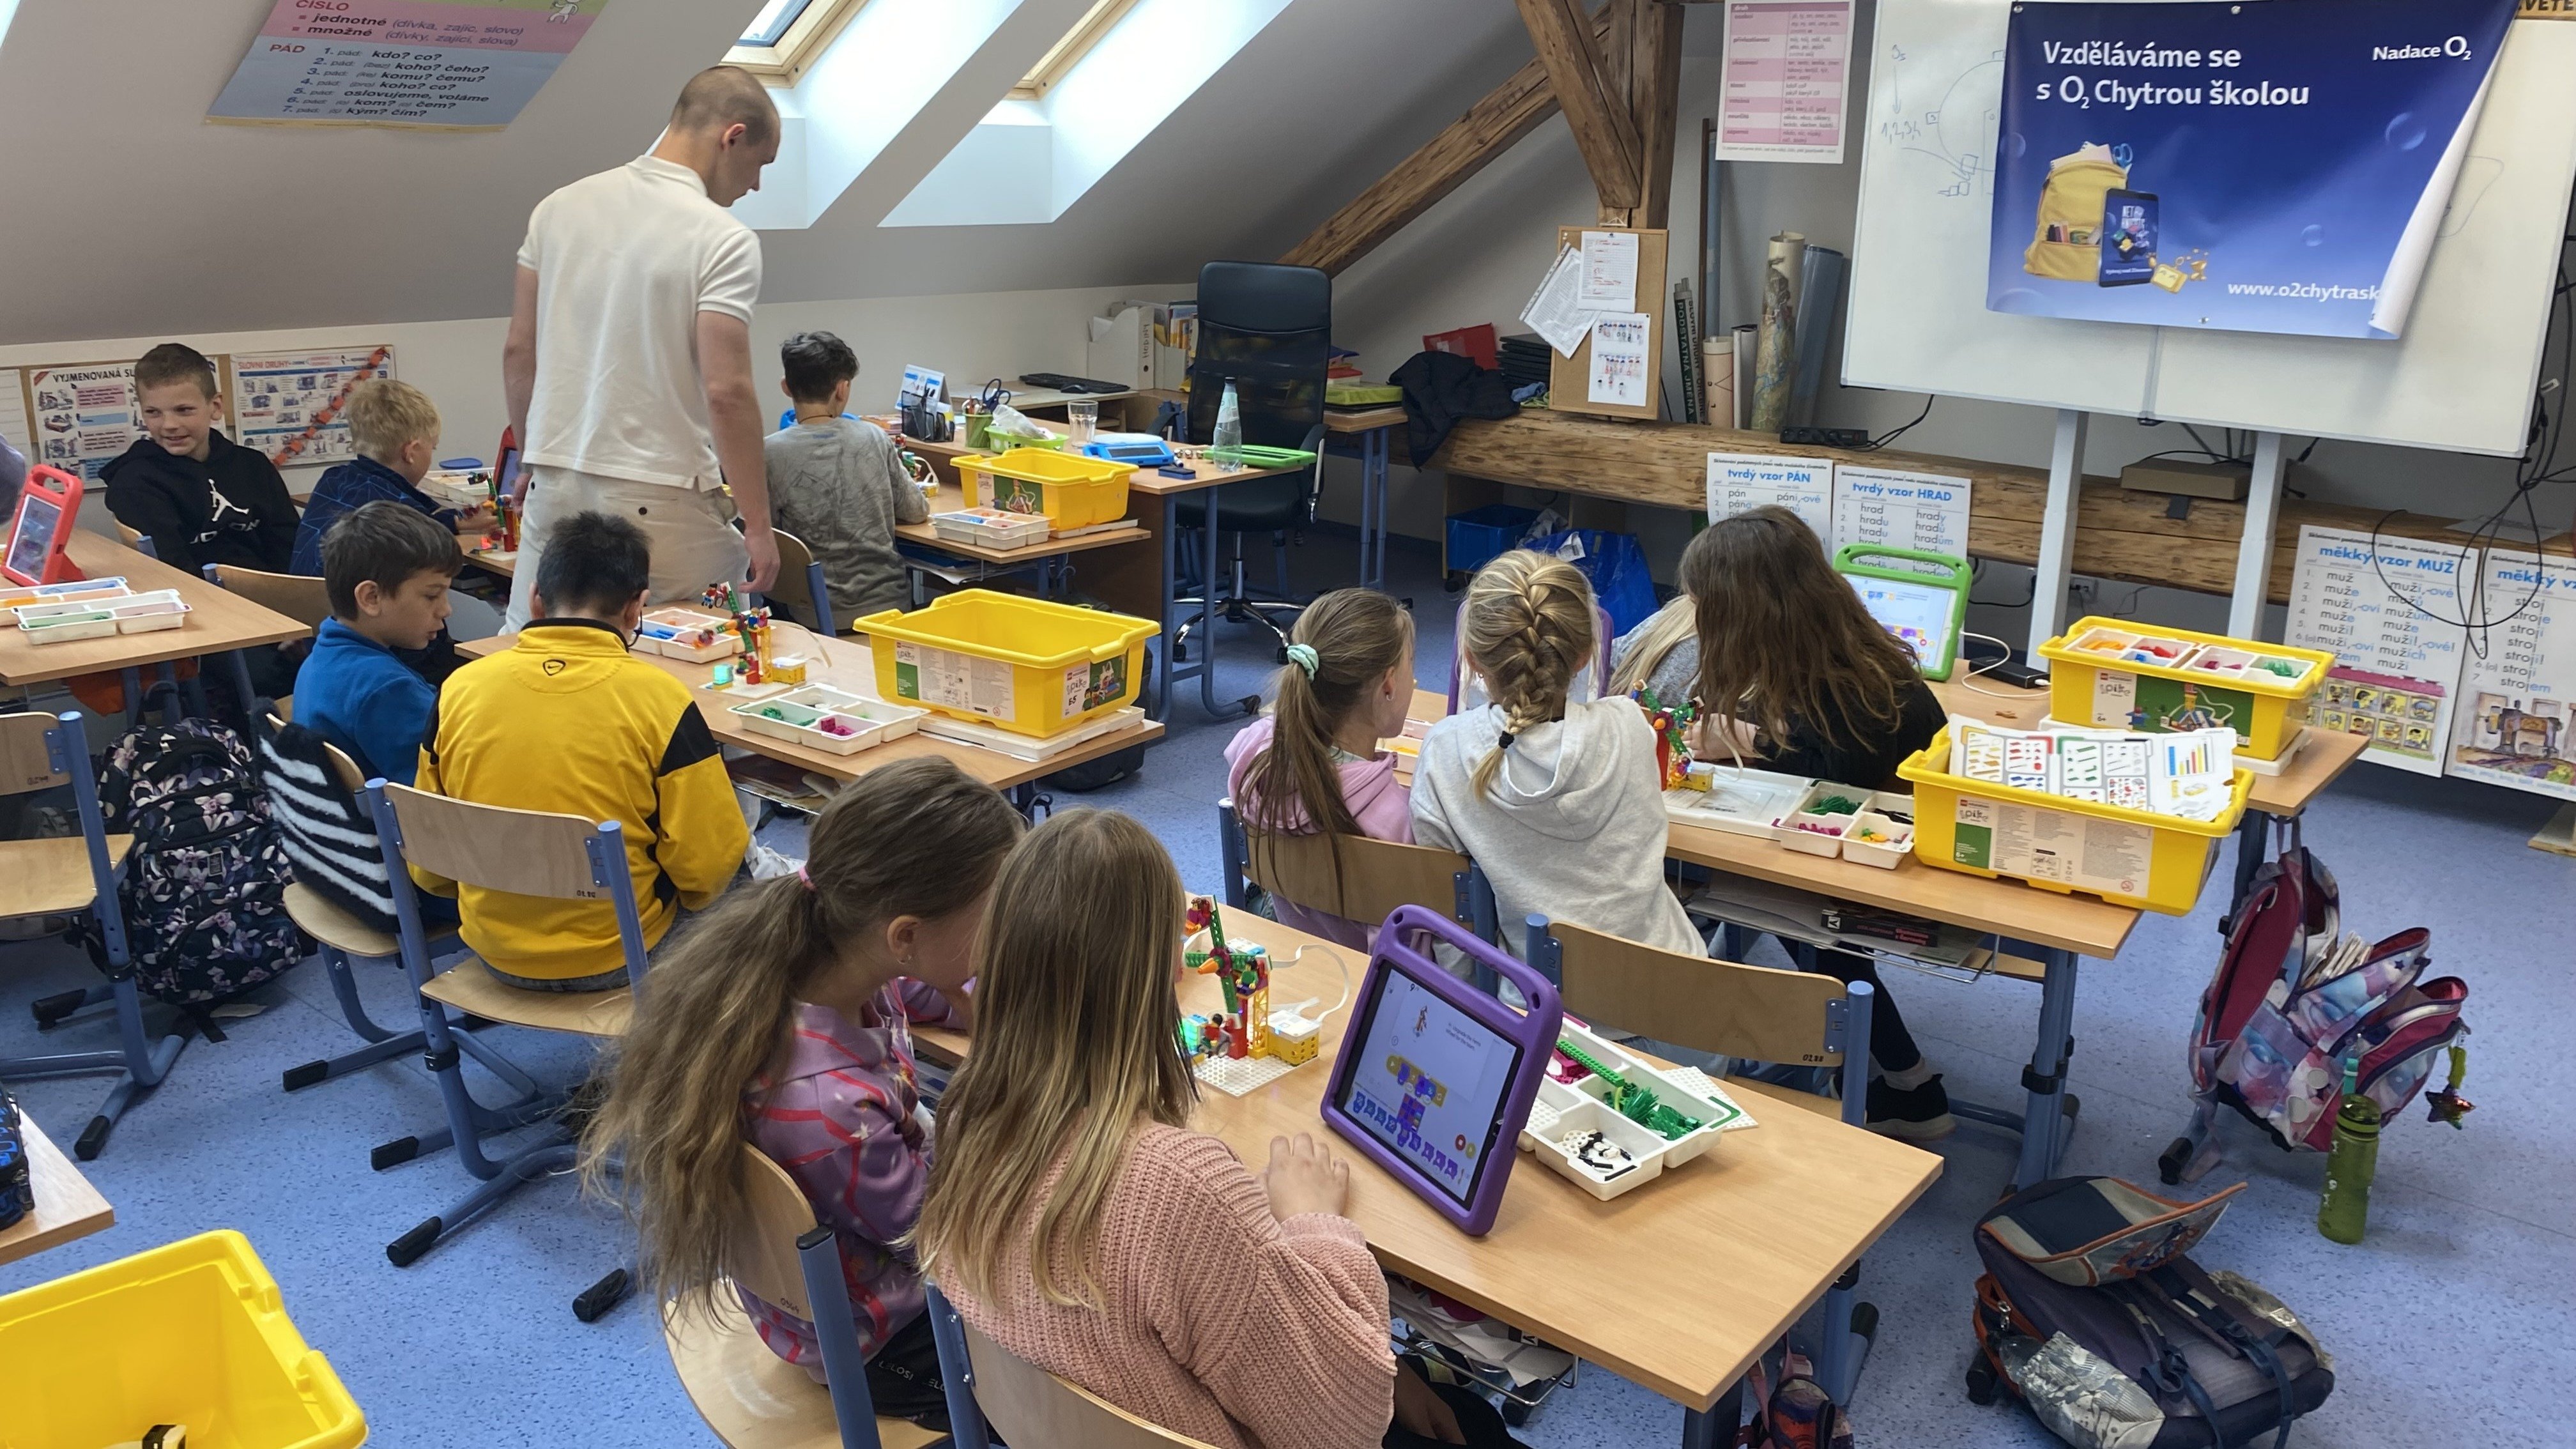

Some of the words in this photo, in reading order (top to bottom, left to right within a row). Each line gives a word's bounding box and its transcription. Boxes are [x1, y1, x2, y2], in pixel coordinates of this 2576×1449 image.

[312, 13, 387, 26] jednotné
[307, 26, 372, 37] množné
[372, 50, 410, 59] kdo?
[2043, 40, 2201, 68] Vzděláváme
[2208, 48, 2242, 68] se
[2372, 45, 2441, 62] Nadace
[395, 62, 441, 72] koho?
[445, 65, 489, 73] čeho?
[381, 72, 433, 80] komu?
[436, 74, 486, 83] čemu?
[379, 82, 426, 90] koho?
[344, 90, 432, 100] oslovujeme,
[438, 93, 490, 102] voláme
[2035, 82, 2051, 100] s
[2094, 79, 2201, 111] Chytrou
[2209, 80, 2310, 106] školou
[354, 99, 396, 107] kom?
[416, 101, 457, 109] čem?
[346, 107, 388, 116] kým?
[391, 109, 427, 117] čím?
[53, 367, 122, 383] VYJMENOVANÁ
[1728, 469, 1756, 482] tvrdý
[1787, 470, 1811, 482] PÁN
[1728, 489, 1746, 498] pán
[1853, 482, 1884, 496] tvrdý
[1887, 487, 1914, 498] vzor
[1917, 488, 1952, 502] HRAD
[1728, 500, 1752, 509] pána
[1860, 502, 1884, 514] hrad
[1917, 509, 1947, 523] hrady
[1860, 514, 1889, 526] hradu
[1915, 520, 1945, 533] hradů
[1859, 525, 1888, 537] hradu
[1914, 533, 1954, 546] hradům
[2319, 546, 2373, 565] měkký
[2378, 554, 2412, 567] vzor
[2416, 558, 2455, 574] MUŽ
[2326, 571, 2354, 583] muž
[2324, 583, 2359, 597] muže
[2320, 609, 2356, 623] muže
[2383, 620, 2419, 633] muže
[2385, 607, 2434, 622] mužům
[2319, 623, 2354, 636] muži!
[2507, 637, 2537, 653] stroj
[2379, 645, 2426, 661] mužích
[2377, 658, 2409, 671] muži
[2501, 677, 2551, 693] strojem
